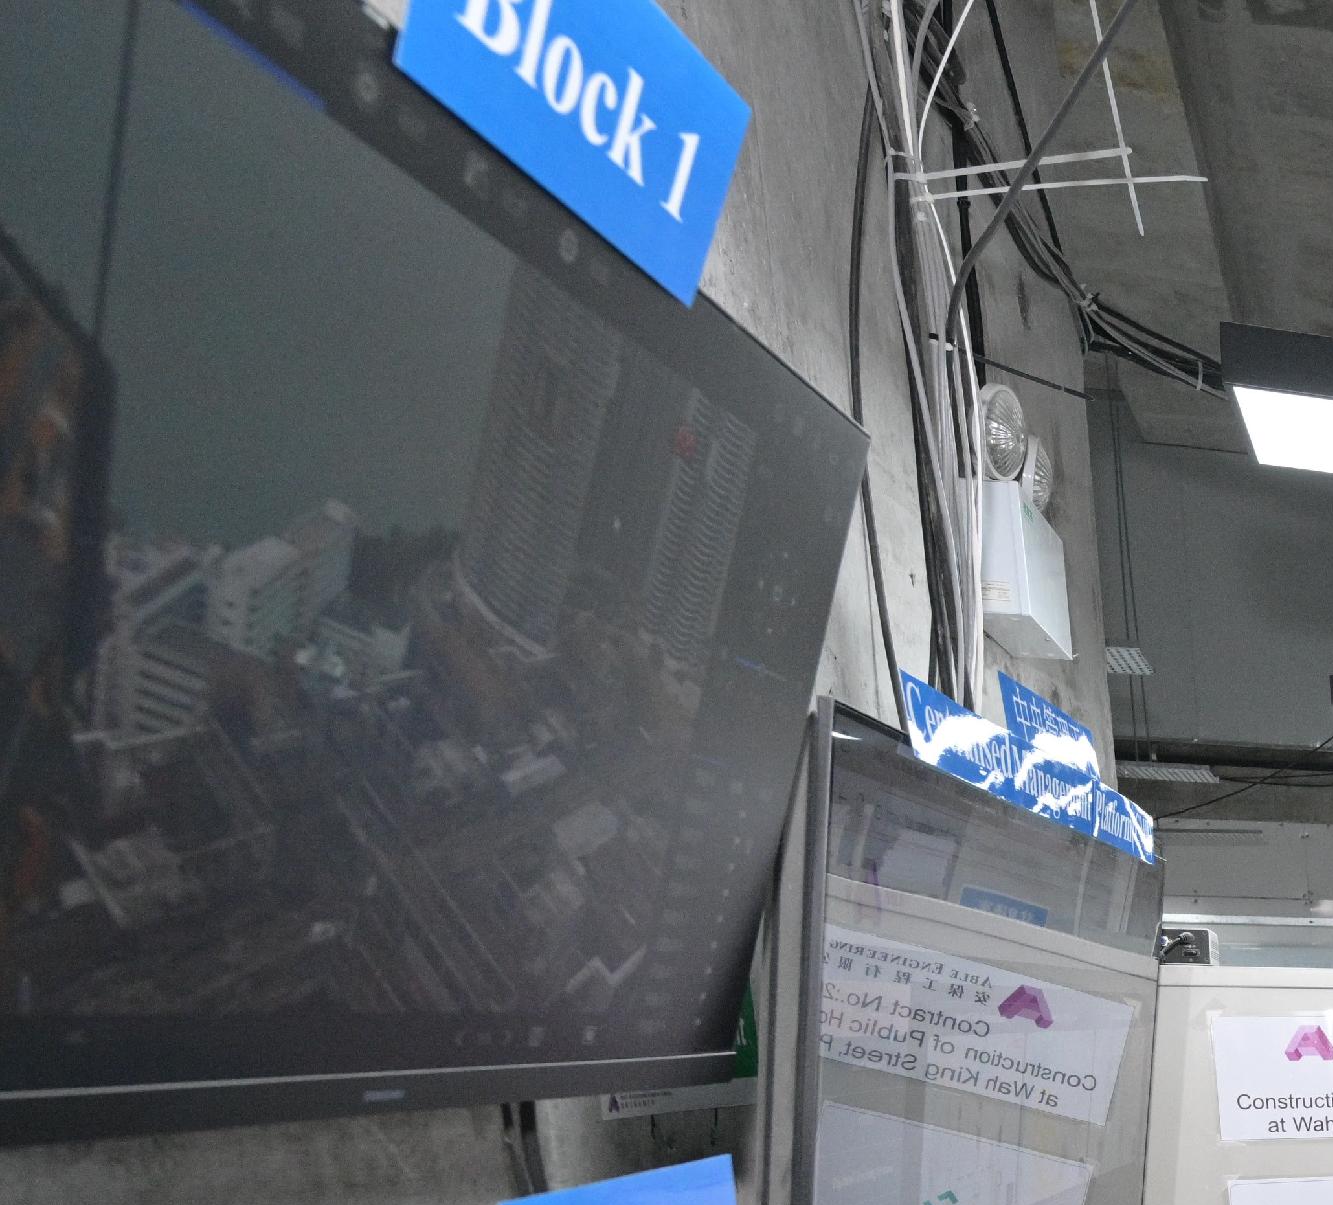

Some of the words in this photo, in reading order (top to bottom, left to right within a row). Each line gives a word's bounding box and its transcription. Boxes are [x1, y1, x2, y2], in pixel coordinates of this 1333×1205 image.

[455, 0, 660, 188] Block
[660, 132, 702, 224] 1
[1268, 1117, 1287, 1133] at
